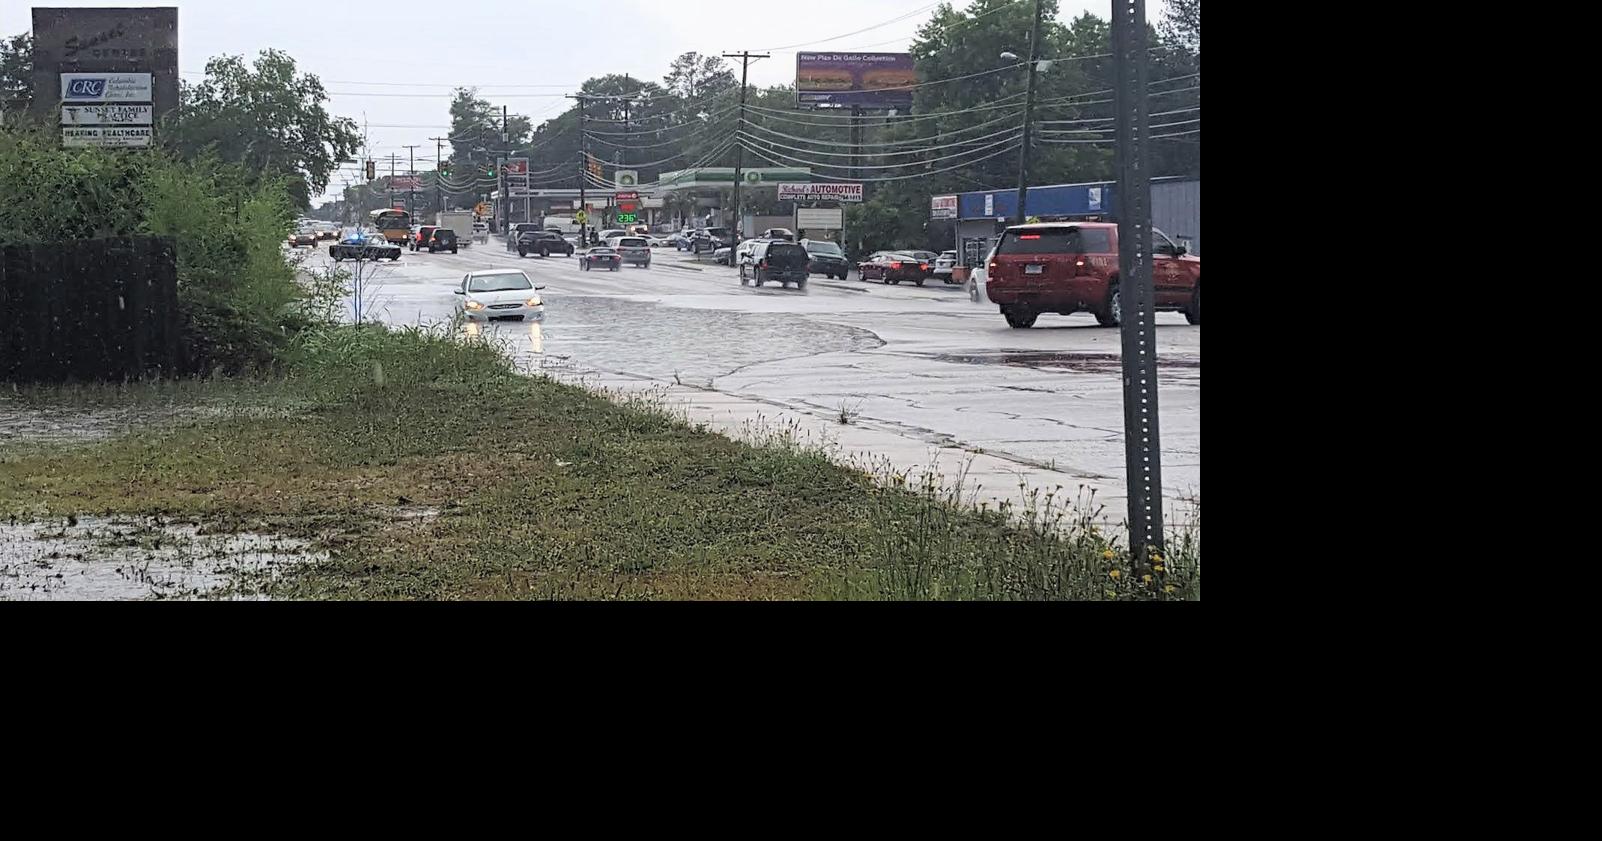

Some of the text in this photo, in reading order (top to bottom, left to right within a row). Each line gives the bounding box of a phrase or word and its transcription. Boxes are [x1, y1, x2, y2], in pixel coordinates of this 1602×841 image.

[72, 80, 102, 96] CRC
[65, 129, 150, 137] HEARING HEALTHCARE
[811, 185, 861, 194] AUTOMOTIVE
